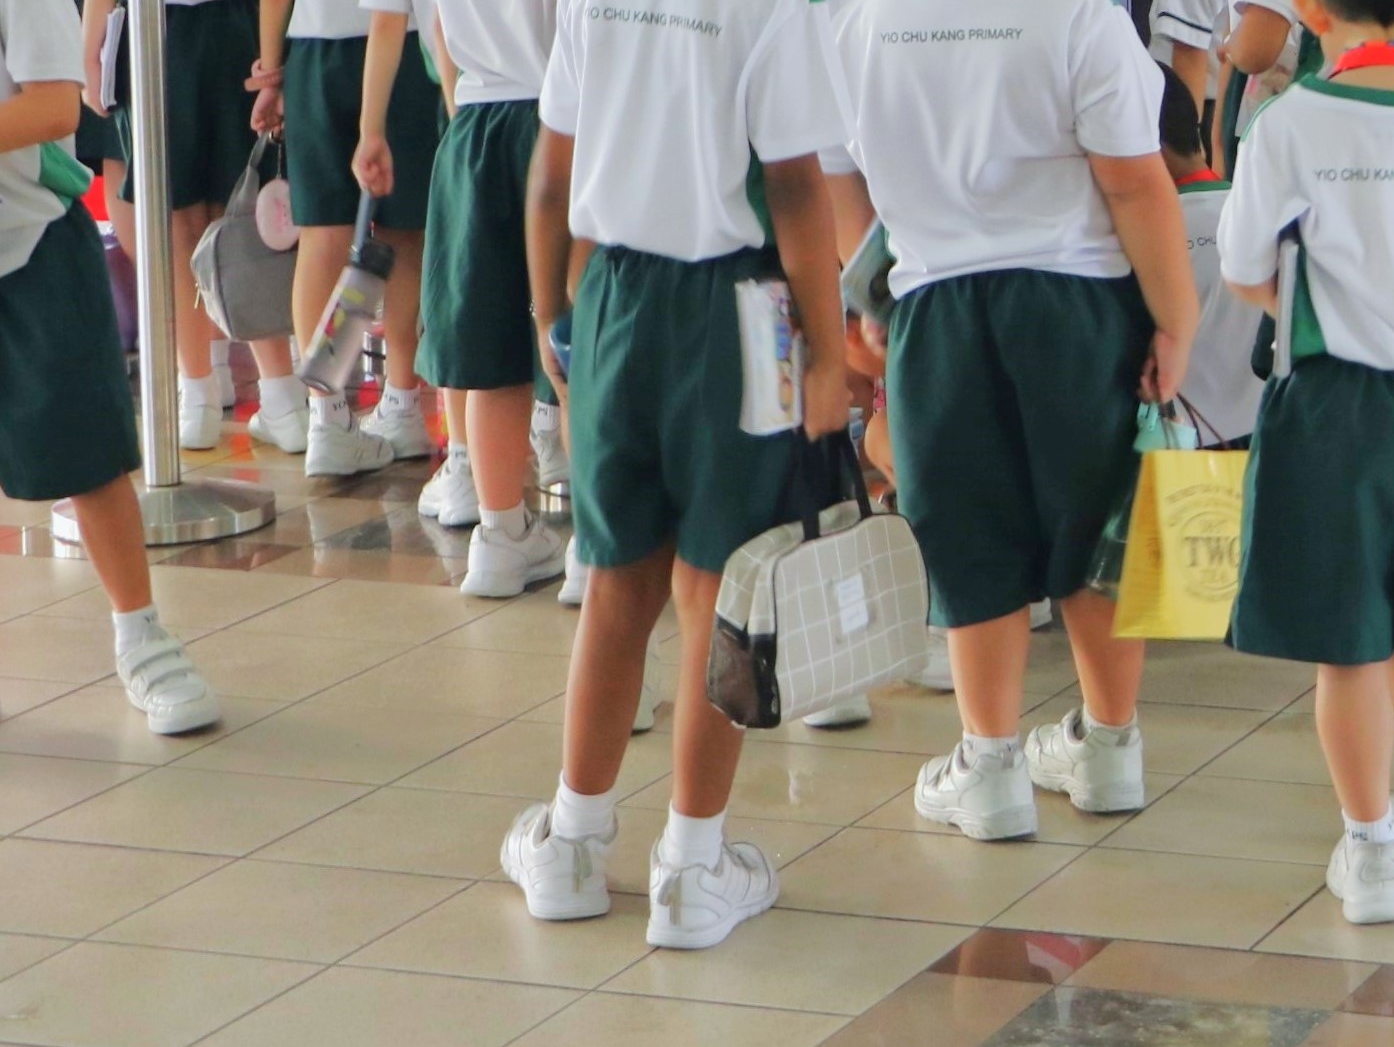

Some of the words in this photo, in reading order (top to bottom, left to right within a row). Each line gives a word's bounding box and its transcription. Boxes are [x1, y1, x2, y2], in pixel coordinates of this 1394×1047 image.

[603, 6, 631, 22] CHU
[633, 10, 667, 27] KANG
[669, 14, 722, 37] PRIMARY
[880, 31, 899, 44] YIO
[901, 30, 928, 43] CHU
[931, 29, 965, 43] KANG
[968, 27, 1023, 41] PRIMARY
[1313, 168, 1338, 182] YIO
[1340, 167, 1370, 181] CHU
